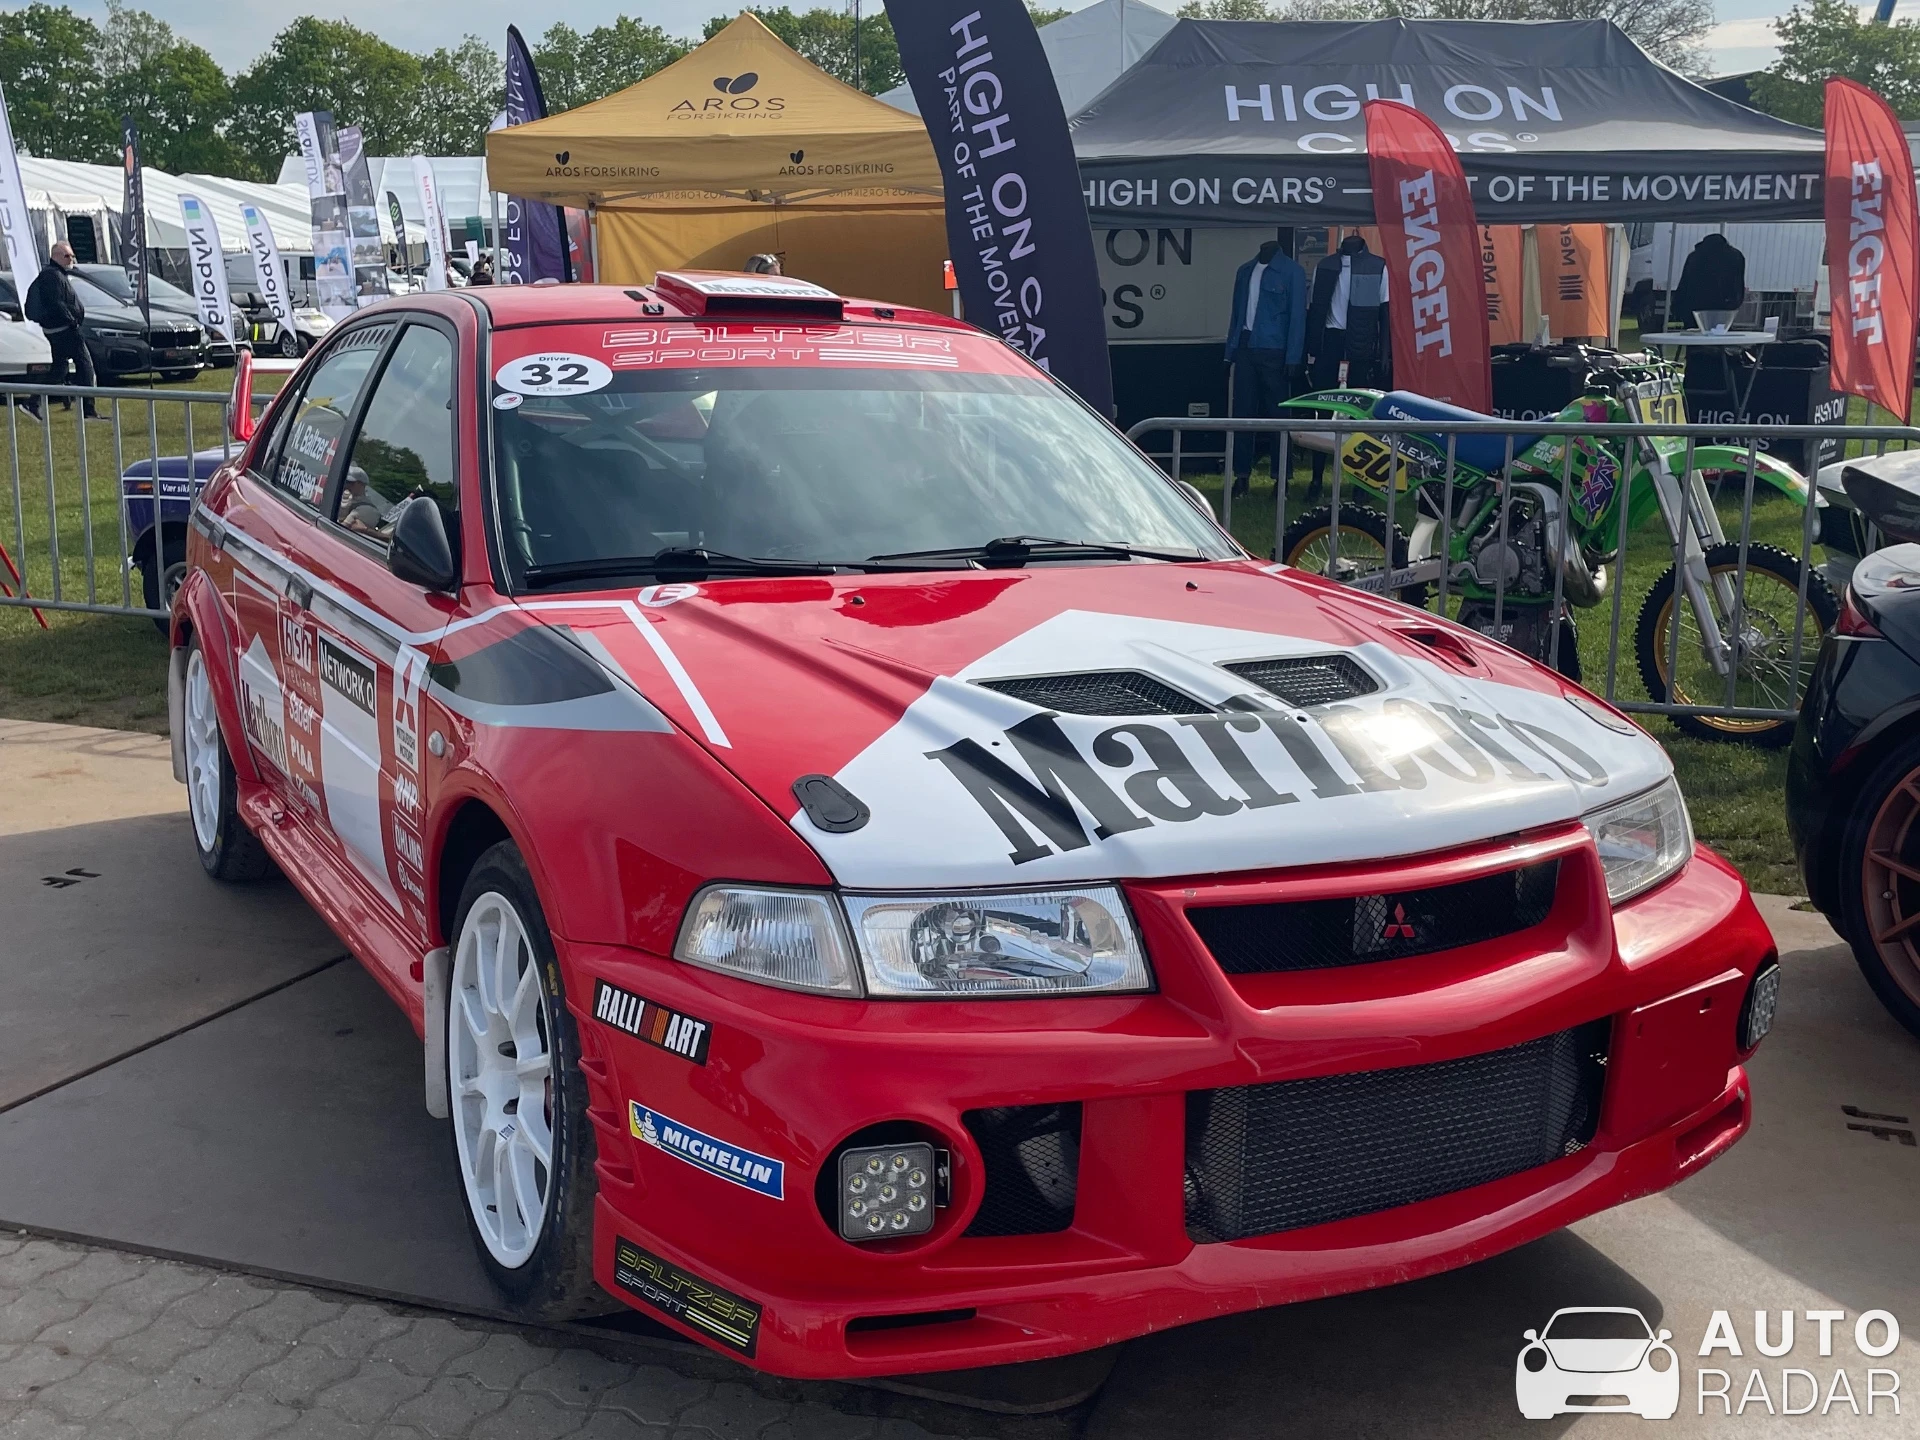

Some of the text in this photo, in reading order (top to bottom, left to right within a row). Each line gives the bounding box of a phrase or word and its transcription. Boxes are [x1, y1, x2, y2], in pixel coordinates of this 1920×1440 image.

[667, 112, 783, 121] FORSIKRING
[669, 97, 786, 112] AROS
[938, 65, 964, 133] PART
[1224, 84, 1563, 121] HIGH ON
[949, 10, 1016, 159] HIGH
[991, 172, 1035, 261] ON
[546, 166, 660, 178] AROS FORSIKRING
[779, 163, 894, 176] AROS FORSIKRING
[954, 141, 976, 179] OF
[1169, 178, 1220, 206] ON
[1488, 175, 1535, 202] OF
[1545, 175, 1610, 202] THE
[1622, 173, 1820, 202] MOVEMENT
[962, 184, 993, 242] THE
[602, 325, 953, 352] BALTZER
[612, 347, 815, 366] SPORT
[520, 364, 590, 386] 32
[1342, 439, 1404, 482] 50
[162, 483, 176, 492] Vær
[320, 641, 375, 714] NETWORK Q
[924, 692, 1608, 865] Marlboro
[596, 984, 706, 1059] RALLI ART
[662, 1125, 773, 1184] MICHELIN
[616, 1268, 687, 1313] SPORT
[617, 1244, 759, 1330] BALTZER
